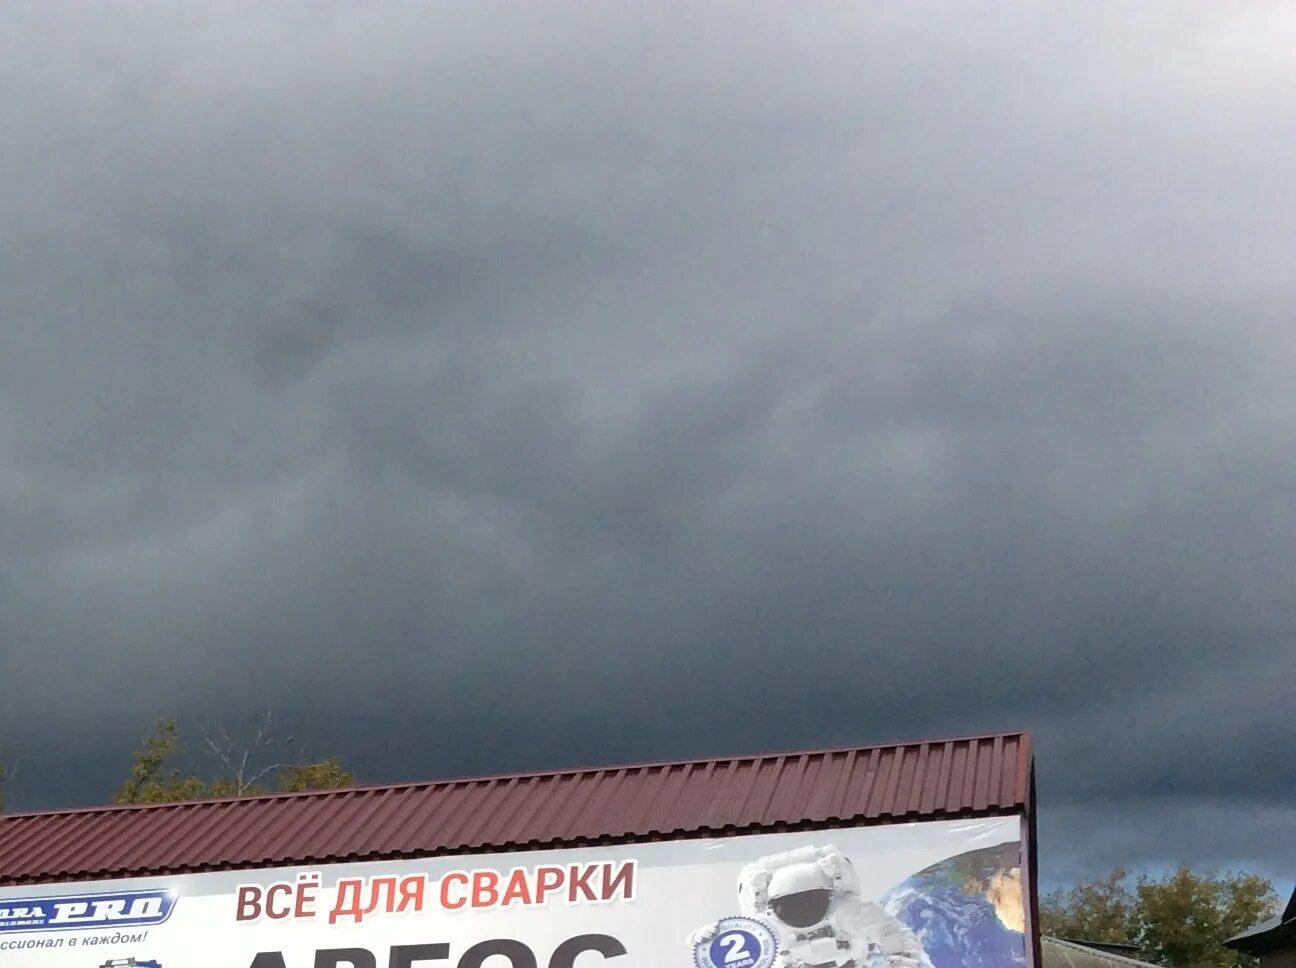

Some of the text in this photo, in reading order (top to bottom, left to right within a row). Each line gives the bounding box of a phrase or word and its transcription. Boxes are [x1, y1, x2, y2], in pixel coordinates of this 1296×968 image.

[48, 891, 164, 924] PRO
[235, 861, 636, 924] ВСЁ ДЛЯ СВАРКИ
[68, 937, 78, 947] в
[81, 930, 150, 948] каждом!
[719, 933, 751, 964] 2
